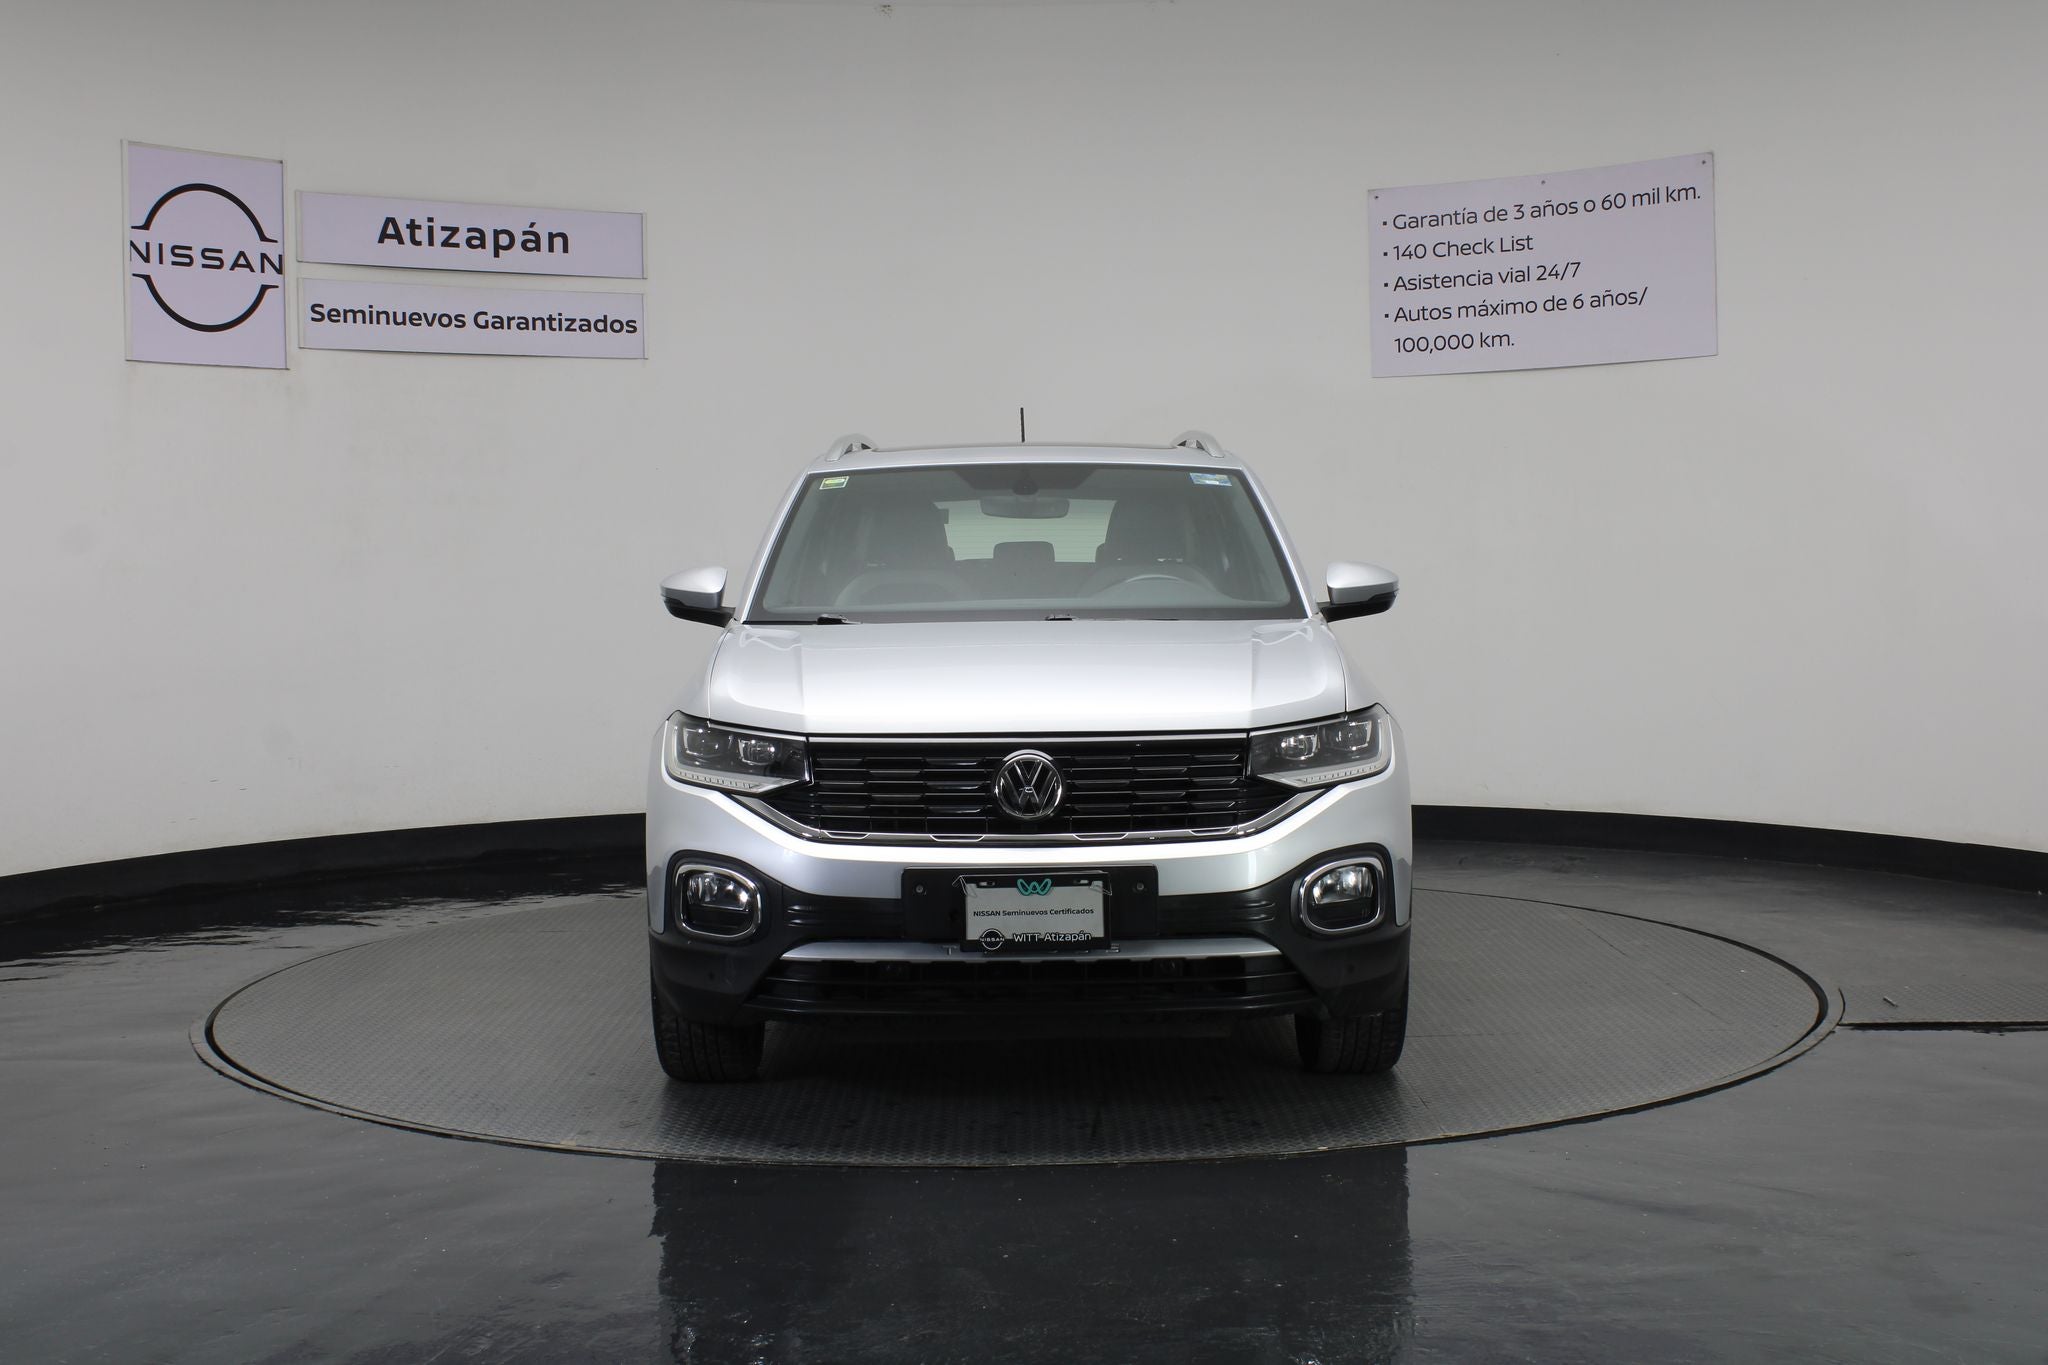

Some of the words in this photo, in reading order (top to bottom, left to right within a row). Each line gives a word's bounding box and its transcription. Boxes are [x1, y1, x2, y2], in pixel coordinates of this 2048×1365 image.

[1393, 208, 1477, 229] Garantía
[1484, 206, 1507, 222] de
[1514, 204, 1524, 220] 3
[1531, 200, 1578, 218] años
[1584, 200, 1595, 212] o
[1602, 193, 1626, 210] 60
[1632, 187, 1659, 207] mil
[1666, 186, 1700, 203] km.
[378, 217, 570, 258] Atizapán
[1393, 244, 1426, 260] 140
[1433, 238, 1494, 257] Check
[1501, 235, 1533, 252] List
[130, 240, 283, 275] NISSAN
[1394, 270, 1493, 291] Asistencia
[1498, 266, 1530, 283] vial
[1537, 262, 1581, 281] 24/7
[311, 304, 466, 328] Seminuevos
[474, 311, 637, 333] Garantizados
[1394, 306, 1452, 322] Autos
[1458, 299, 1537, 318] máximo
[1543, 295, 1567, 312] de
[1573, 294, 1584, 309] 6
[1590, 287, 1648, 308] años/
[1395, 334, 1474, 354] 100,000
[1480, 332, 1514, 348] km.
[1003, 909, 1048, 917] Seminuevos
[1050, 908, 1094, 916] Certificados
[1044, 931, 1092, 943] Atizapán
